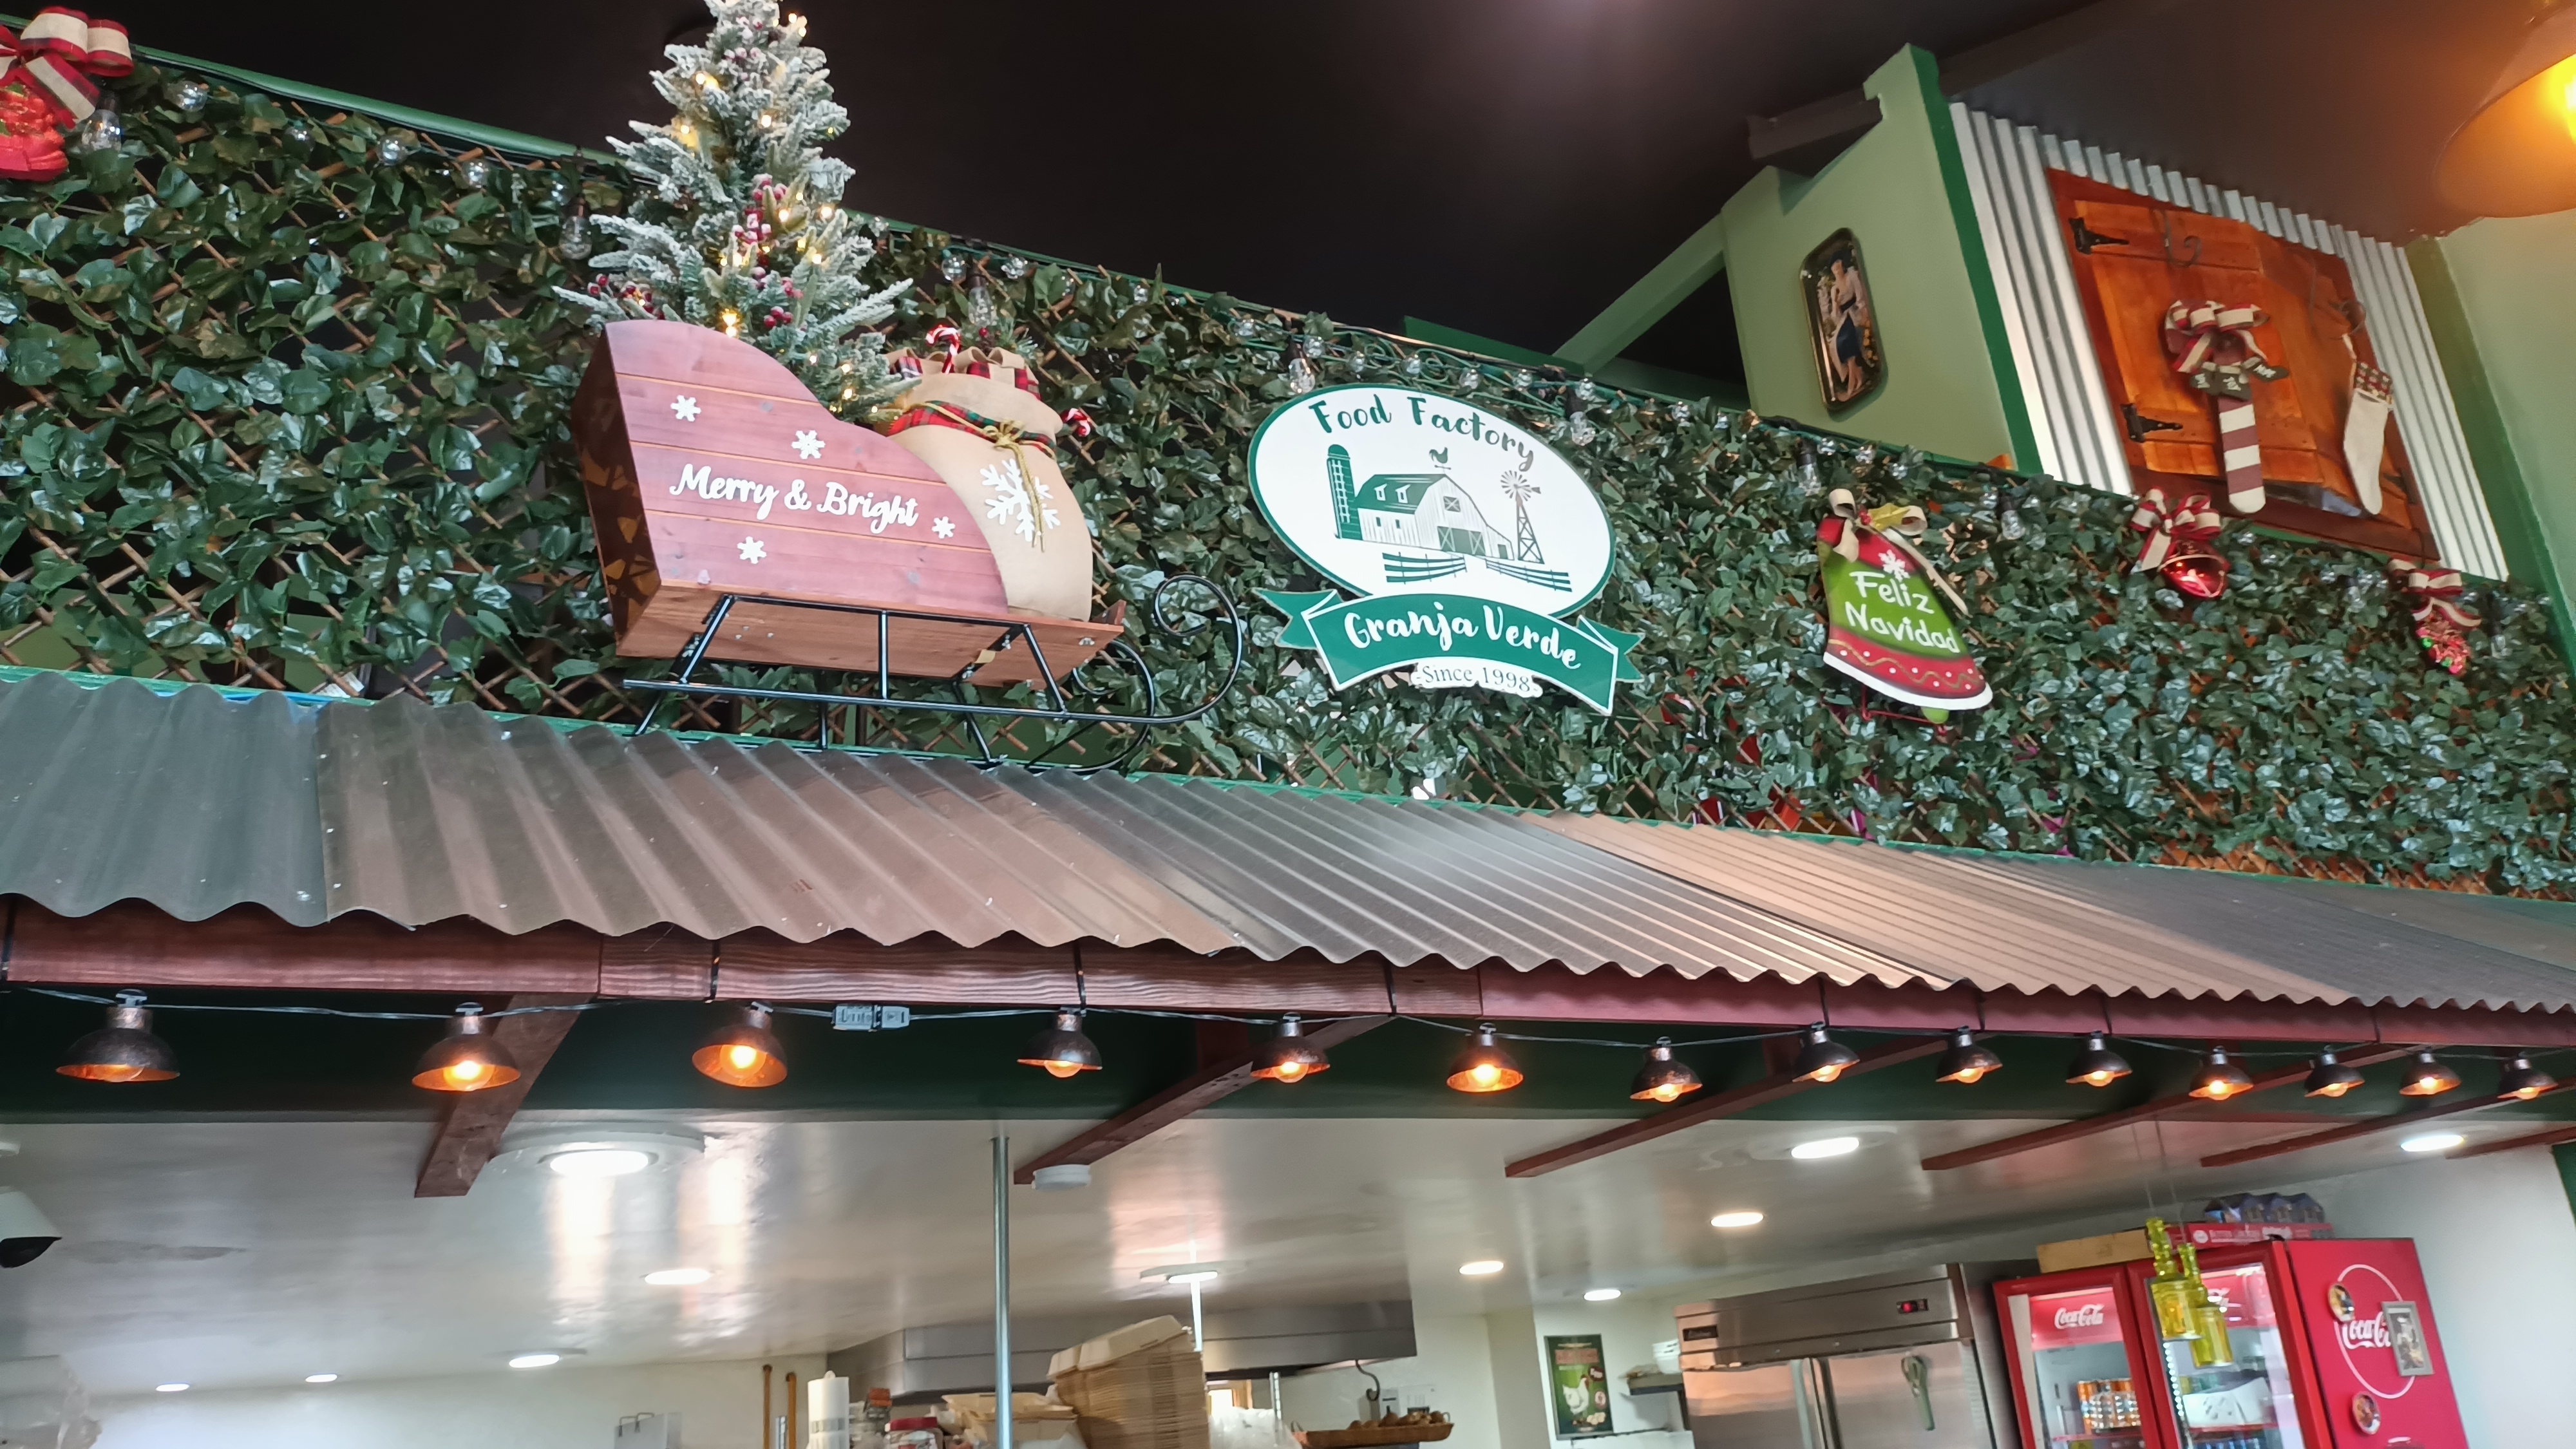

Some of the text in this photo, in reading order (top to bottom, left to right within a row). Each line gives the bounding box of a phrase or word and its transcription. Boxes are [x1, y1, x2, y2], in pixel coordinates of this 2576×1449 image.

[1309, 394, 1535, 472] Food Factory
[669, 464, 919, 534] Merry & Bright
[1849, 571, 1935, 614] Feliz
[1344, 601, 1582, 670] Granja Verde
[1844, 601, 1960, 654] Navidad
